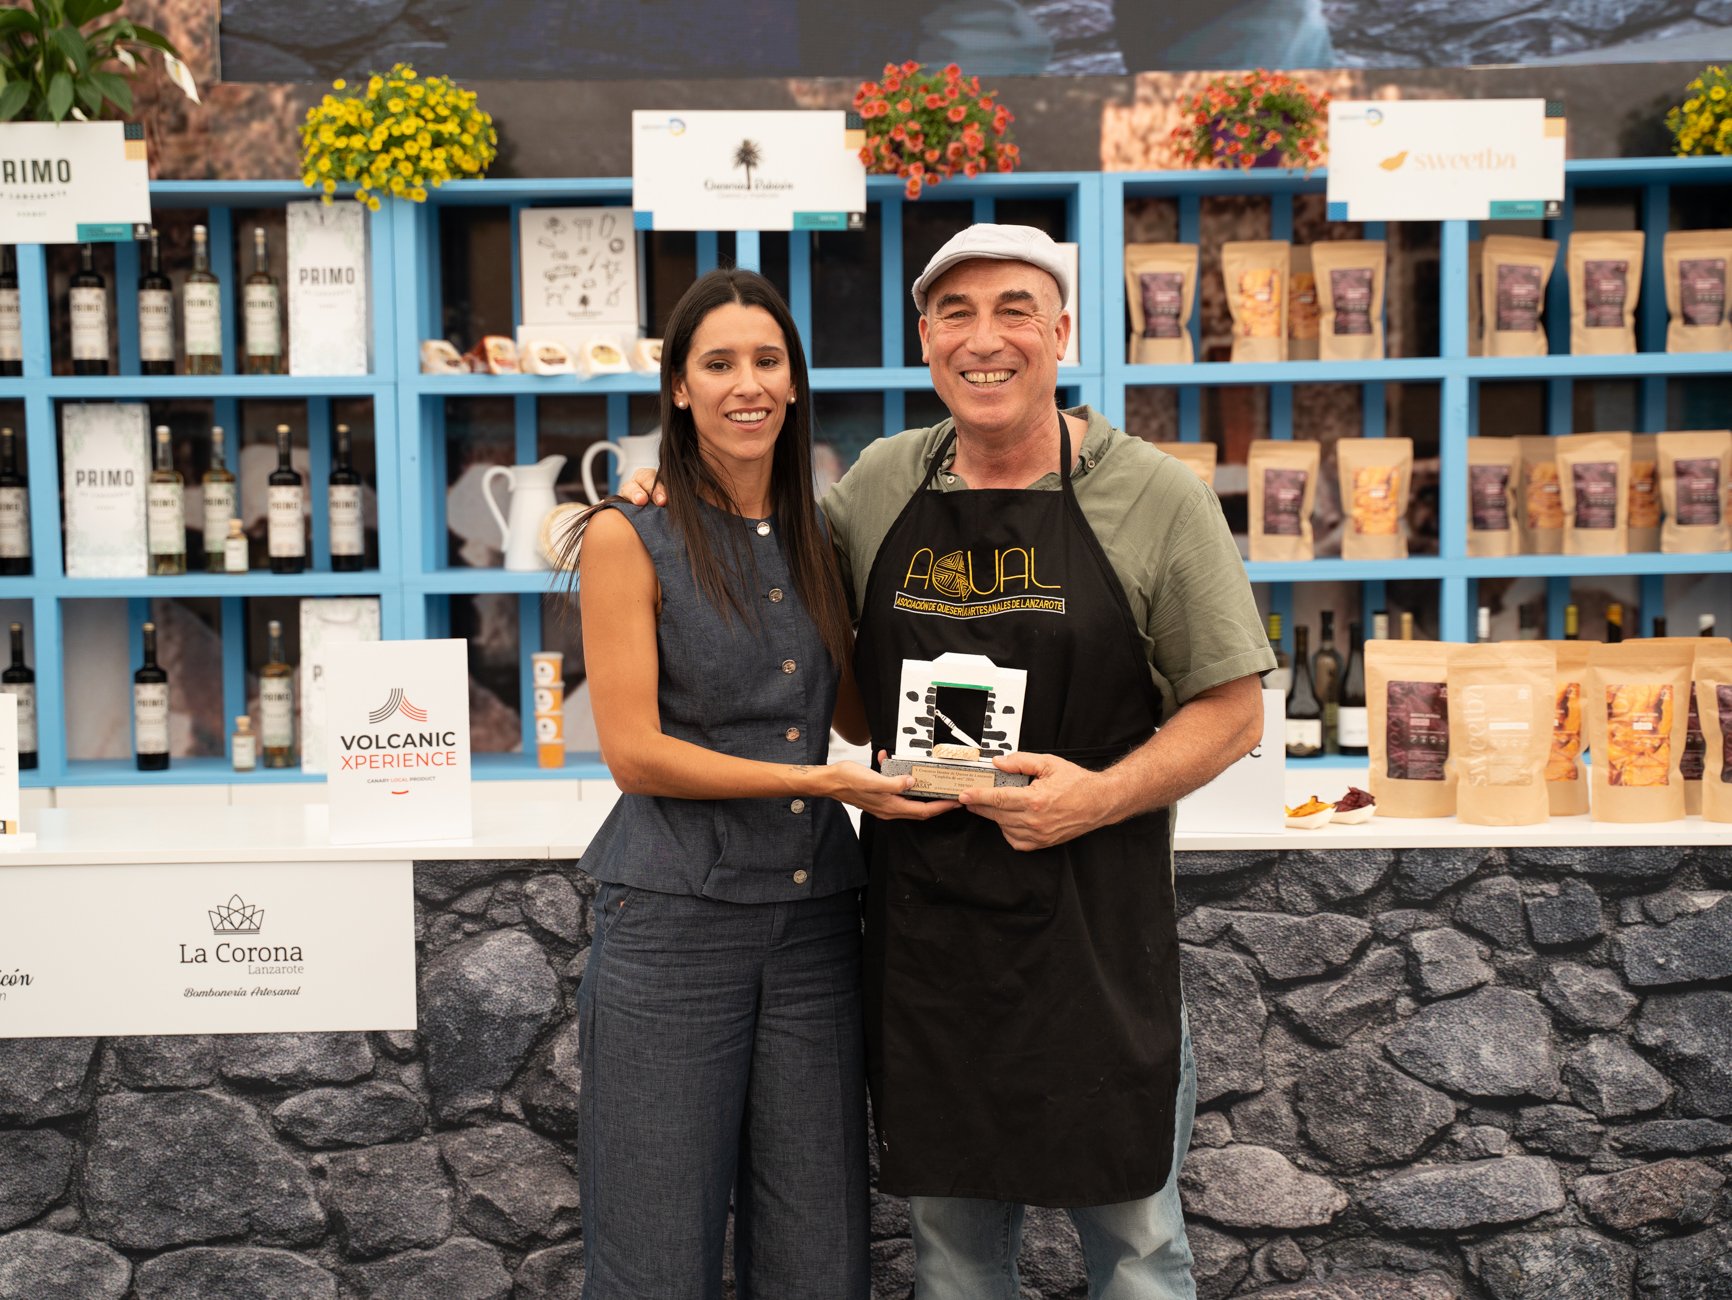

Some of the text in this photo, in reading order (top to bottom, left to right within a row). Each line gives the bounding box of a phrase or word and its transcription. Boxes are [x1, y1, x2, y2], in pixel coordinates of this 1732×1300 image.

[0, 159, 71, 184] RIMO
[299, 267, 356, 285] PRIMO
[76, 469, 135, 488] PRIMO
[1011, 599, 1020, 609] DE
[1021, 599, 1063, 610] LANZAROTE
[341, 731, 456, 751] VOLCANIC
[341, 751, 457, 771] XPERIENCE
[180, 942, 304, 964] La Corona
[248, 965, 305, 975] Lanzarote
[183, 986, 302, 998] Bombonería Artesanal
